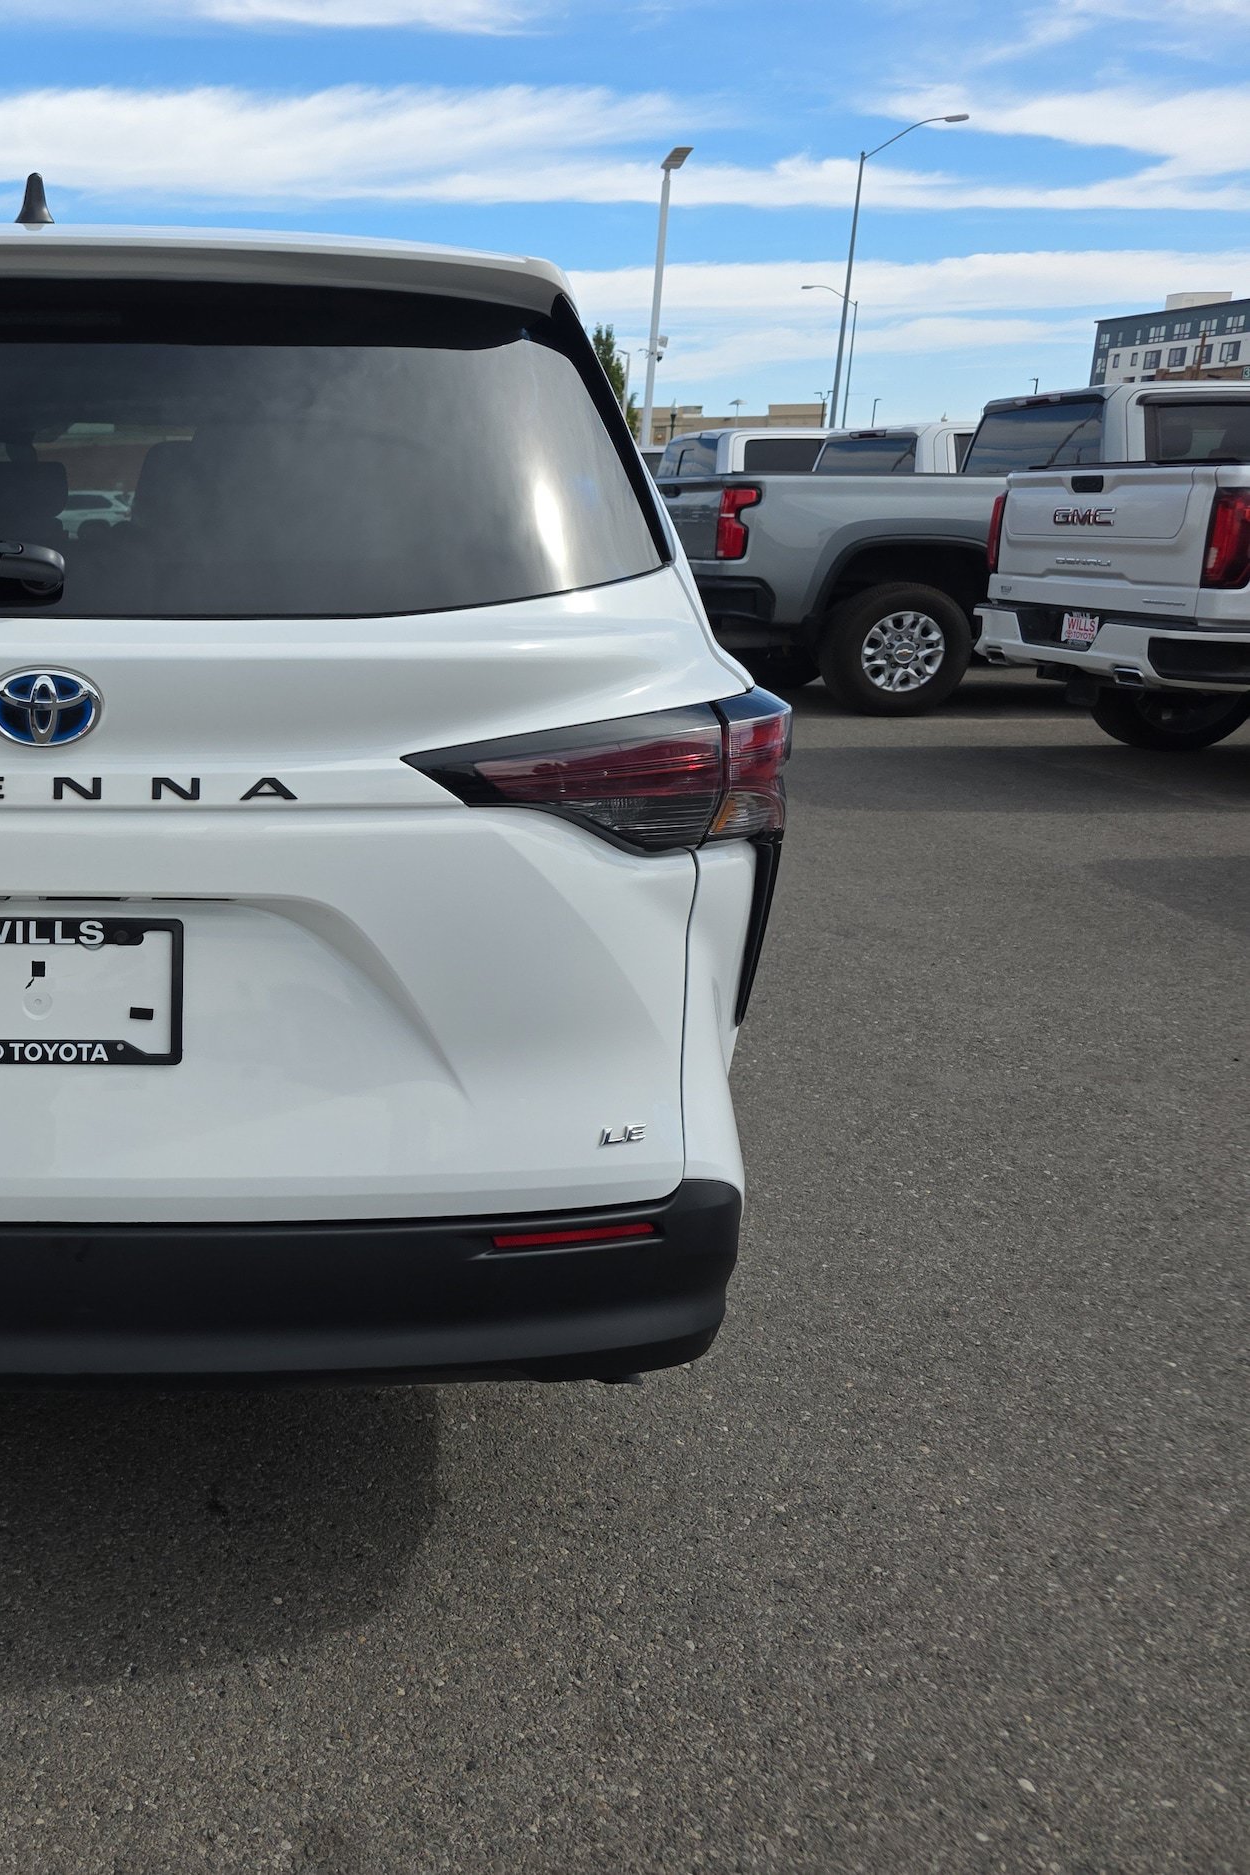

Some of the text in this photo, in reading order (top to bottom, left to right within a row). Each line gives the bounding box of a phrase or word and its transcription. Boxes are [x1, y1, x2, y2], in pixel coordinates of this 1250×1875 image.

[1053, 507, 1116, 526] GMC
[1067, 618, 1096, 632] WILLS
[8, 1043, 110, 1062] TOYOTA
[599, 1123, 647, 1146] LE
